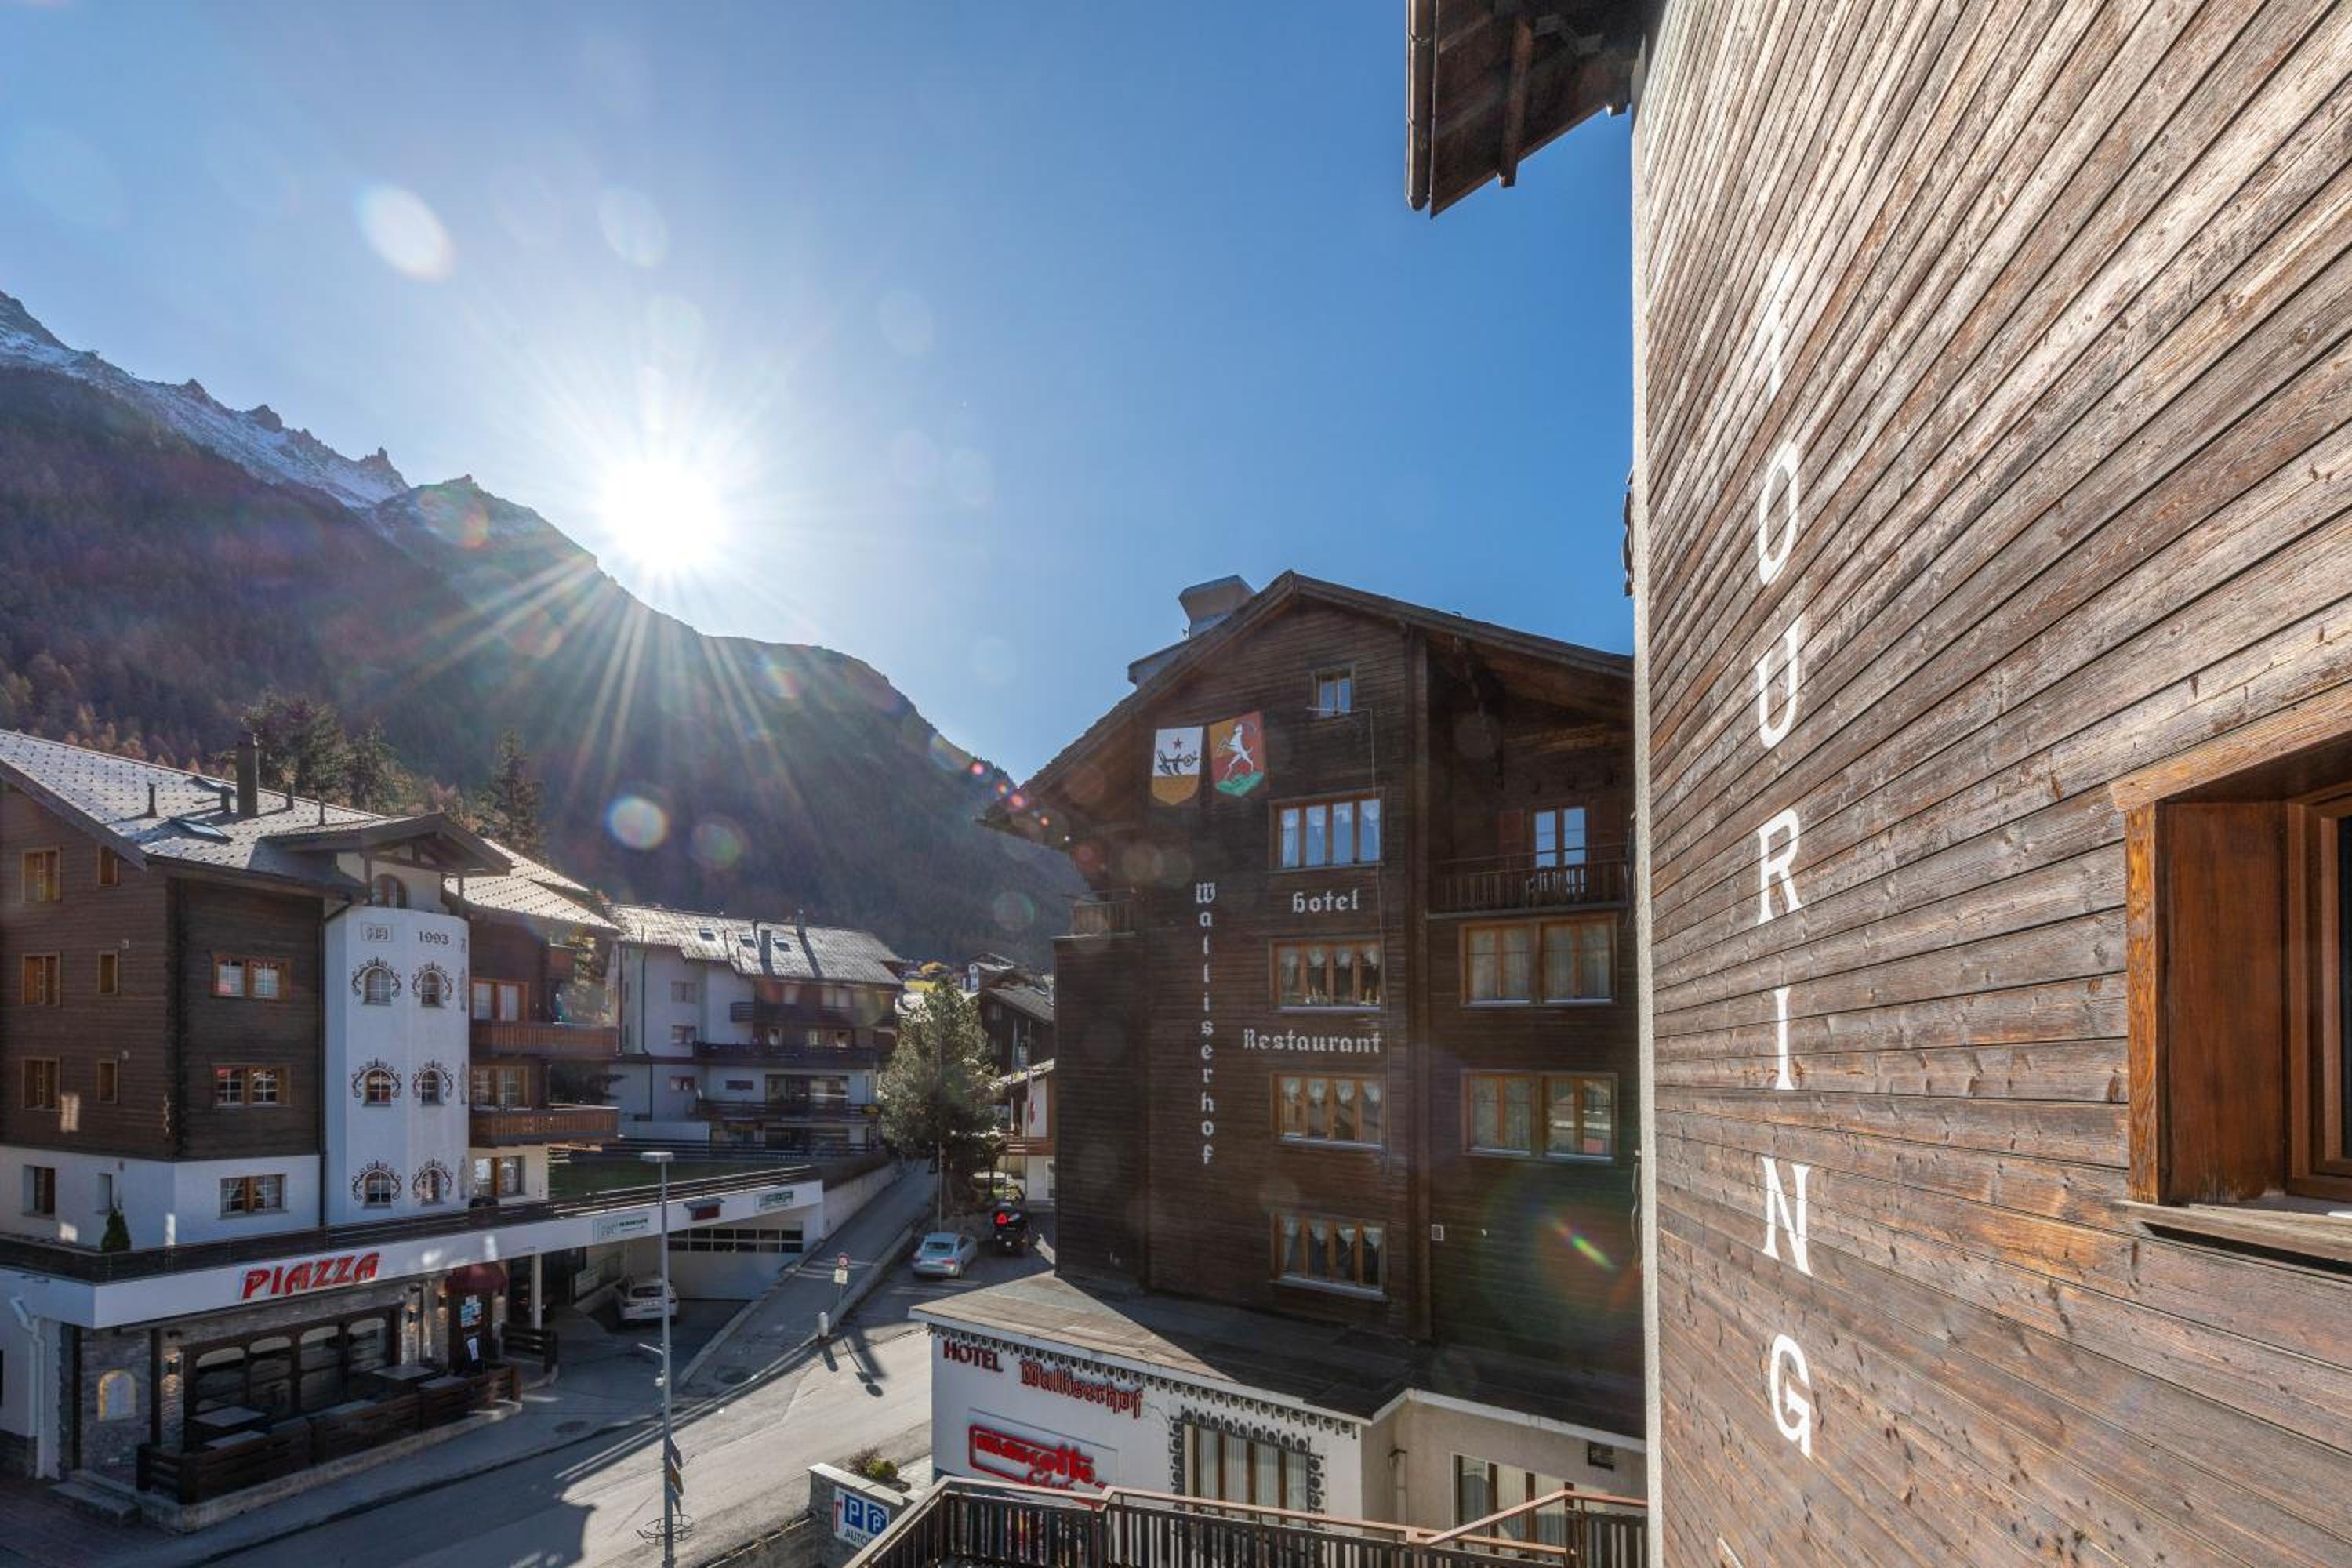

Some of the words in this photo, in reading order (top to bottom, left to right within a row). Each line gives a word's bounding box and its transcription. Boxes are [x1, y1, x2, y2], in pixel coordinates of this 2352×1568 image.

[419, 931, 449, 945] 1993
[1196, 883, 1215, 1165] Walliserhof
[1243, 1028, 1381, 1054] Restaurant
[242, 1252, 380, 1299] PIAZZA
[943, 1340, 1004, 1373] HOTEL
[1020, 1360, 1142, 1419] Walliserhof
[844, 1528, 871, 1548] AUTO
